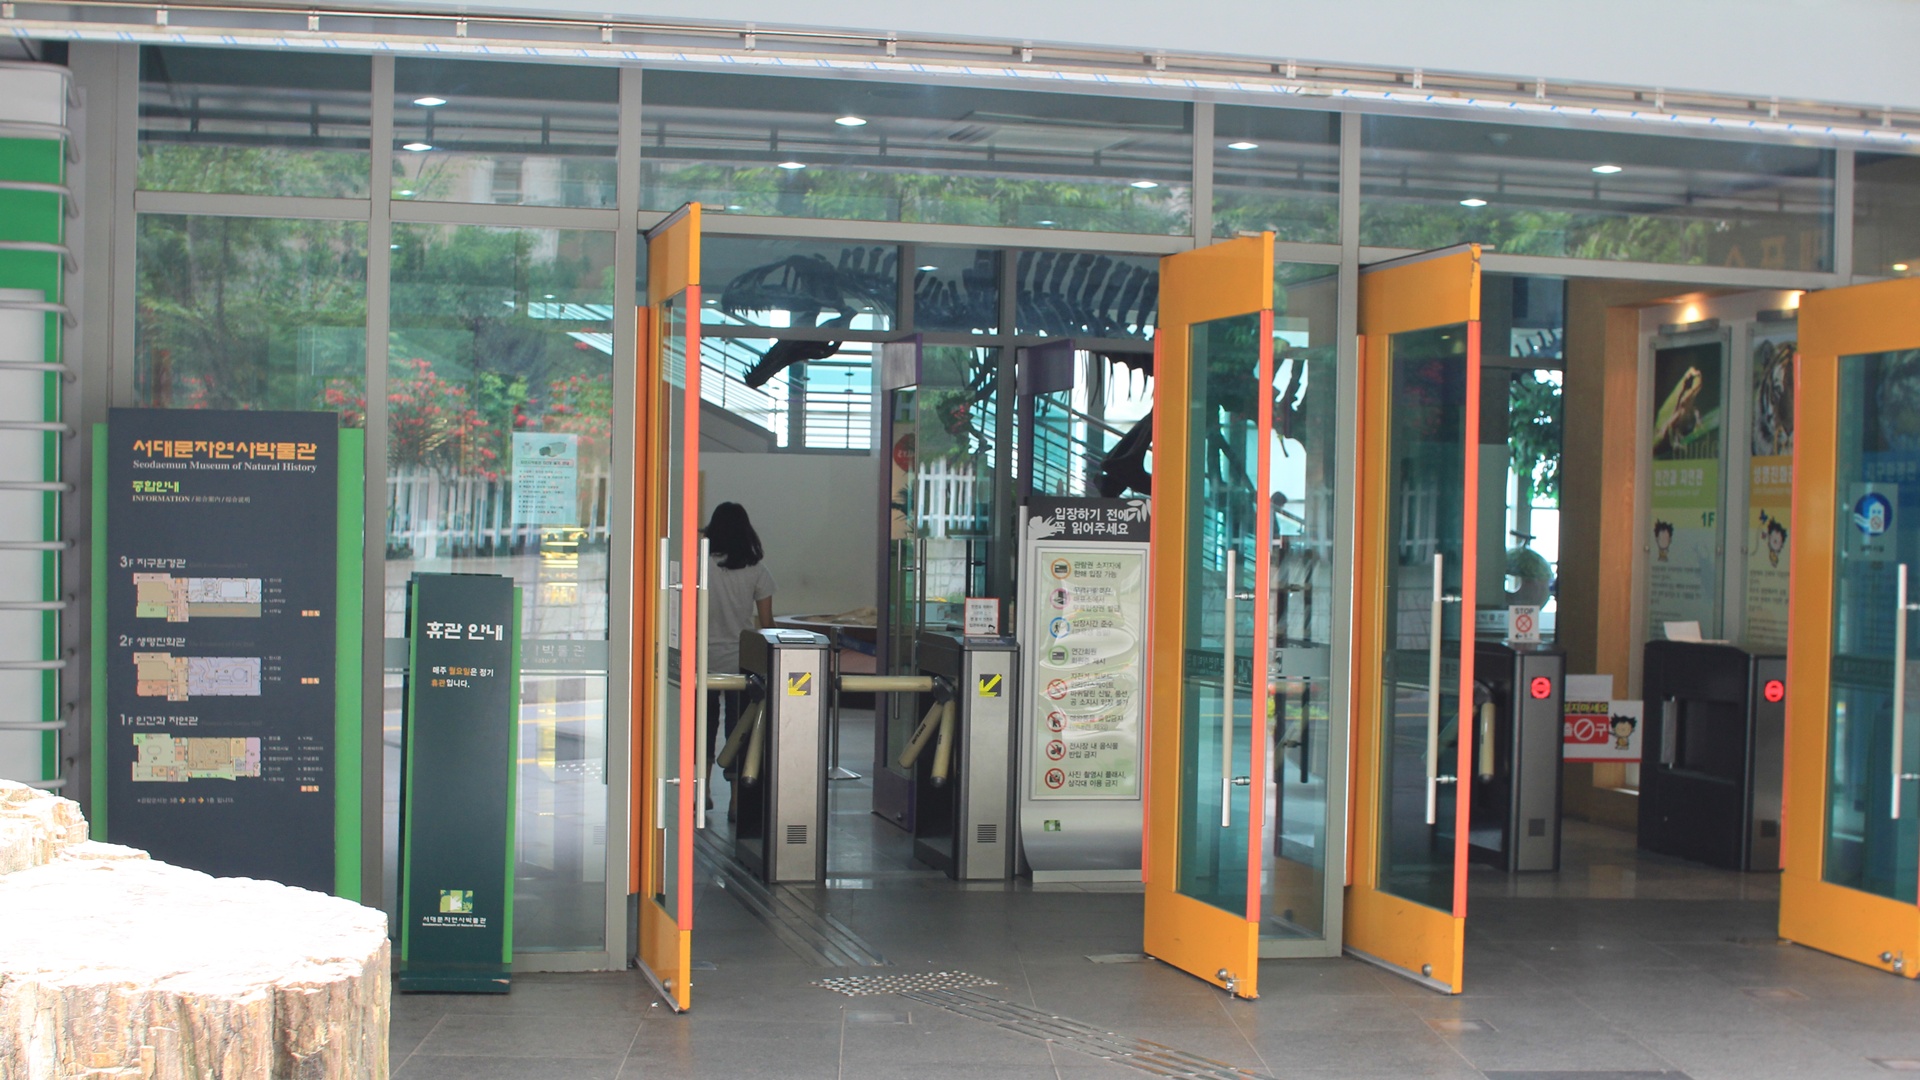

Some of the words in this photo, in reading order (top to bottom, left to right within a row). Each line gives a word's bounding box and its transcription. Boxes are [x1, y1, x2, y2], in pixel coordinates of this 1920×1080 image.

[132, 439, 318, 461] 서대문자연사박물관
[132, 459, 188, 470] Seodaemun
[189, 460, 230, 471] Museum
[232, 460, 243, 471] of
[244, 461, 280, 472] Natural
[282, 461, 318, 474] History
[132, 480, 180, 493] 종합안내
[132, 494, 191, 504] INFORMATION
[1054, 507, 1101, 521] 입장하기
[1106, 508, 1129, 522] 전에
[1701, 511, 1715, 527] 1F
[1055, 522, 1067, 535] 꼭
[1071, 522, 1130, 536] 읽어주세요
[120, 556, 135, 569] 3F
[137, 558, 187, 569] 지구환경관
[1073, 561, 1094, 570] 관람권
[1104, 570, 1117, 579] 가능
[1514, 607, 1534, 615] STOP
[426, 621, 463, 640] 휴관
[467, 623, 504, 642] 안내
[120, 634, 134, 647] 2F
[136, 636, 186, 647] 생명진화관
[431, 665, 447, 676] 매주
[448, 666, 478, 677] 월요일은
[479, 667, 495, 678] 정기
[430, 678, 471, 689] 휴관입니다.
[120, 713, 134, 727] 1F
[136, 715, 166, 727] 인간과
[168, 715, 199, 727] 자연관
[1069, 742, 1089, 750] 전시장
[1090, 742, 1098, 750] 내
[1083, 750, 1097, 759] 금지
[1067, 770, 1082, 779] 사진
[1104, 779, 1119, 788] 금지
[422, 915, 487, 925] 서대문자연사박물관
